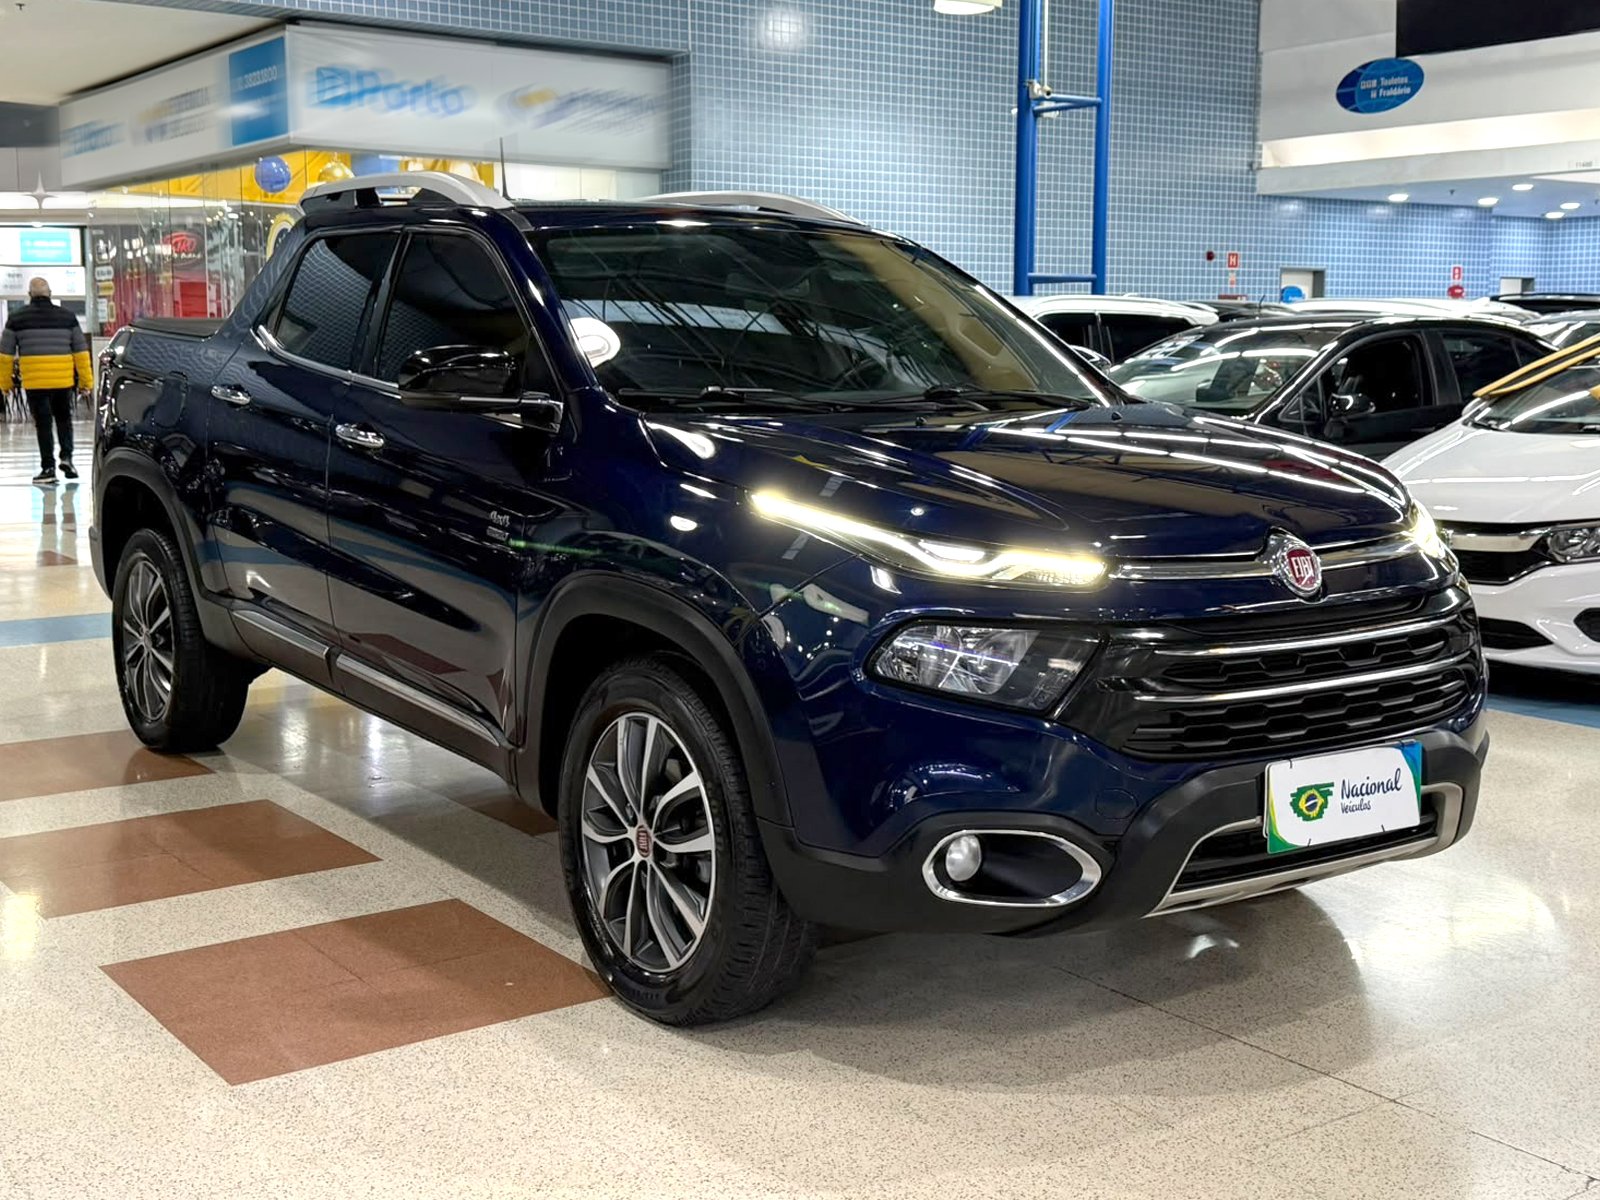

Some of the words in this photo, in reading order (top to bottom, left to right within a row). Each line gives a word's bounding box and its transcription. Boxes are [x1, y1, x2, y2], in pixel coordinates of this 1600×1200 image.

[355, 68, 466, 116] Porto
[1290, 556, 1315, 584] FIAT
[1341, 767, 1402, 799] Nacional
